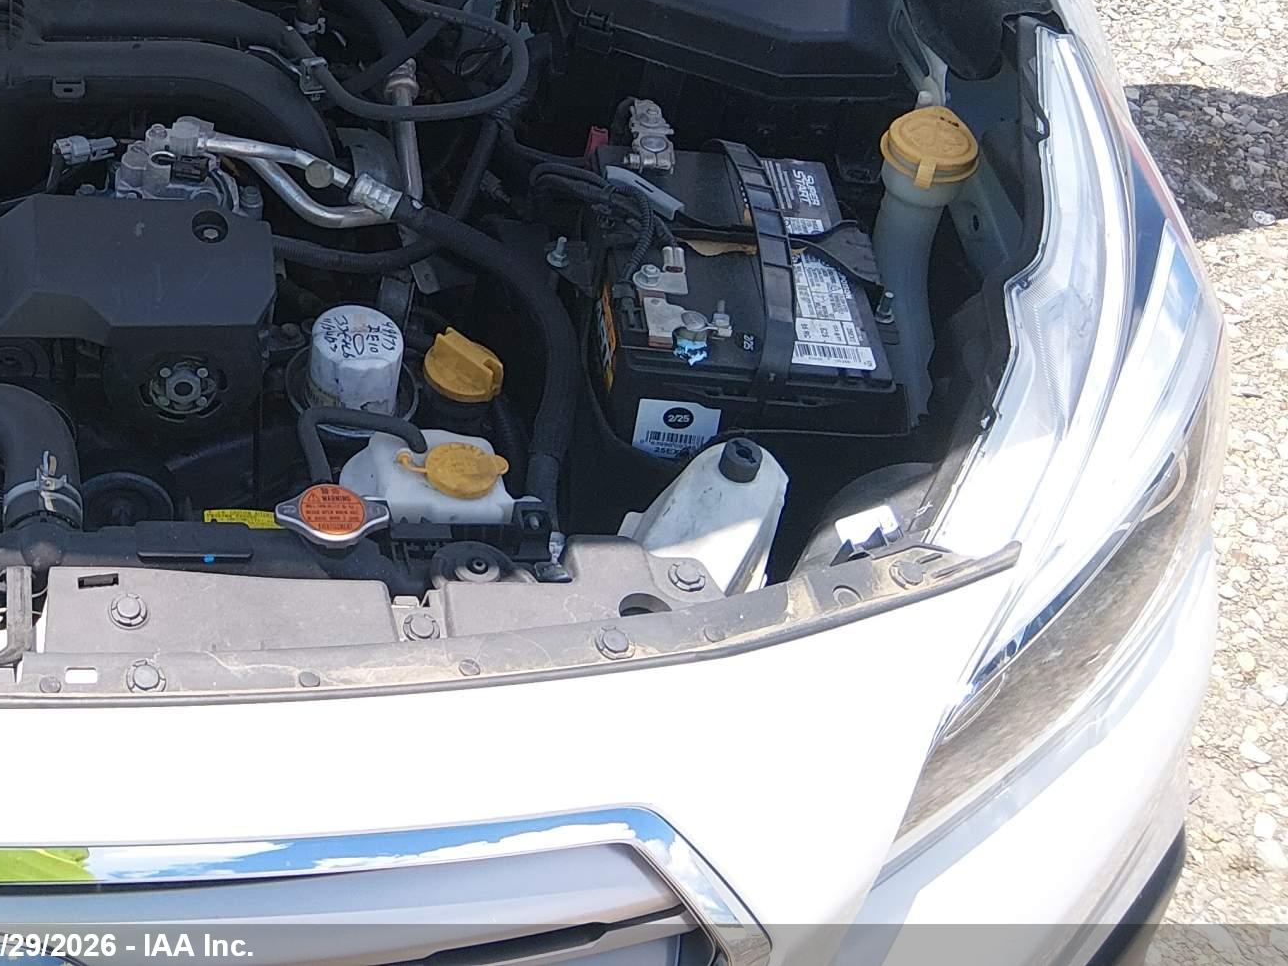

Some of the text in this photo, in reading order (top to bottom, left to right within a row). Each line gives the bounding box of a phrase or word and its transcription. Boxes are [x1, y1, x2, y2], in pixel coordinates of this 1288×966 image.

[792, 170, 811, 206] START
[804, 175, 821, 206] SUPER
[667, 414, 690, 423] 2/25
